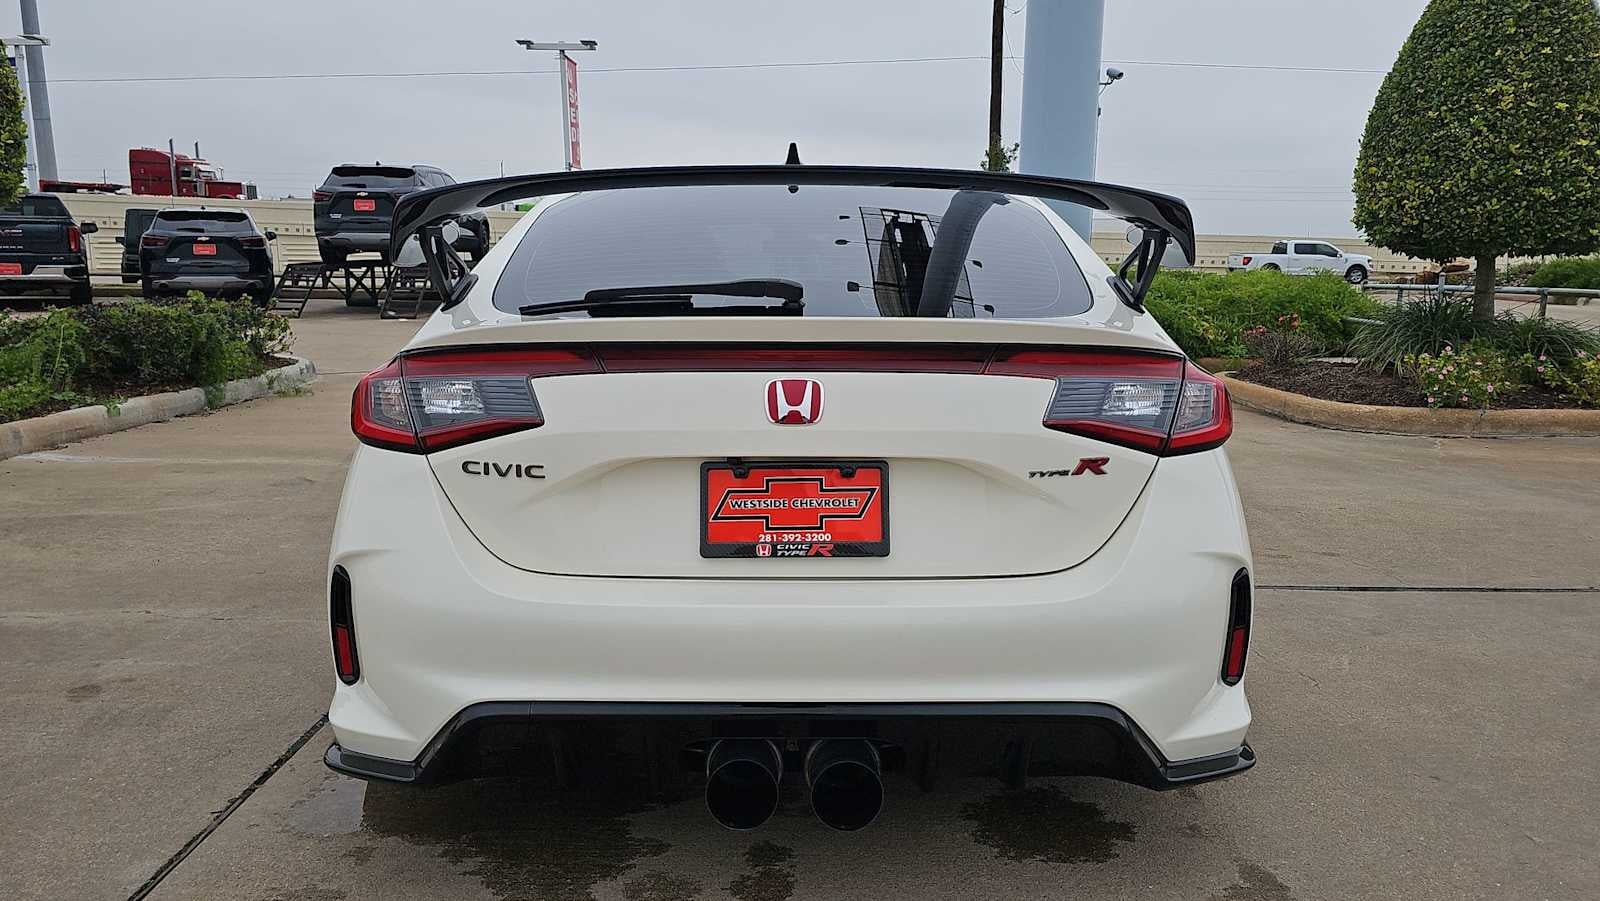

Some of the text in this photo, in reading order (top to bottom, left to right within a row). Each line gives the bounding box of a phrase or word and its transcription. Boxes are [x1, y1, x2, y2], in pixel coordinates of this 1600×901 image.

[461, 460, 546, 479] CIVIC
[1028, 456, 1110, 478] TYPE R
[730, 498, 860, 509] WESTSIDE CHEVROLET
[758, 532, 832, 543] 281-392-3200
[807, 543, 835, 557] R
